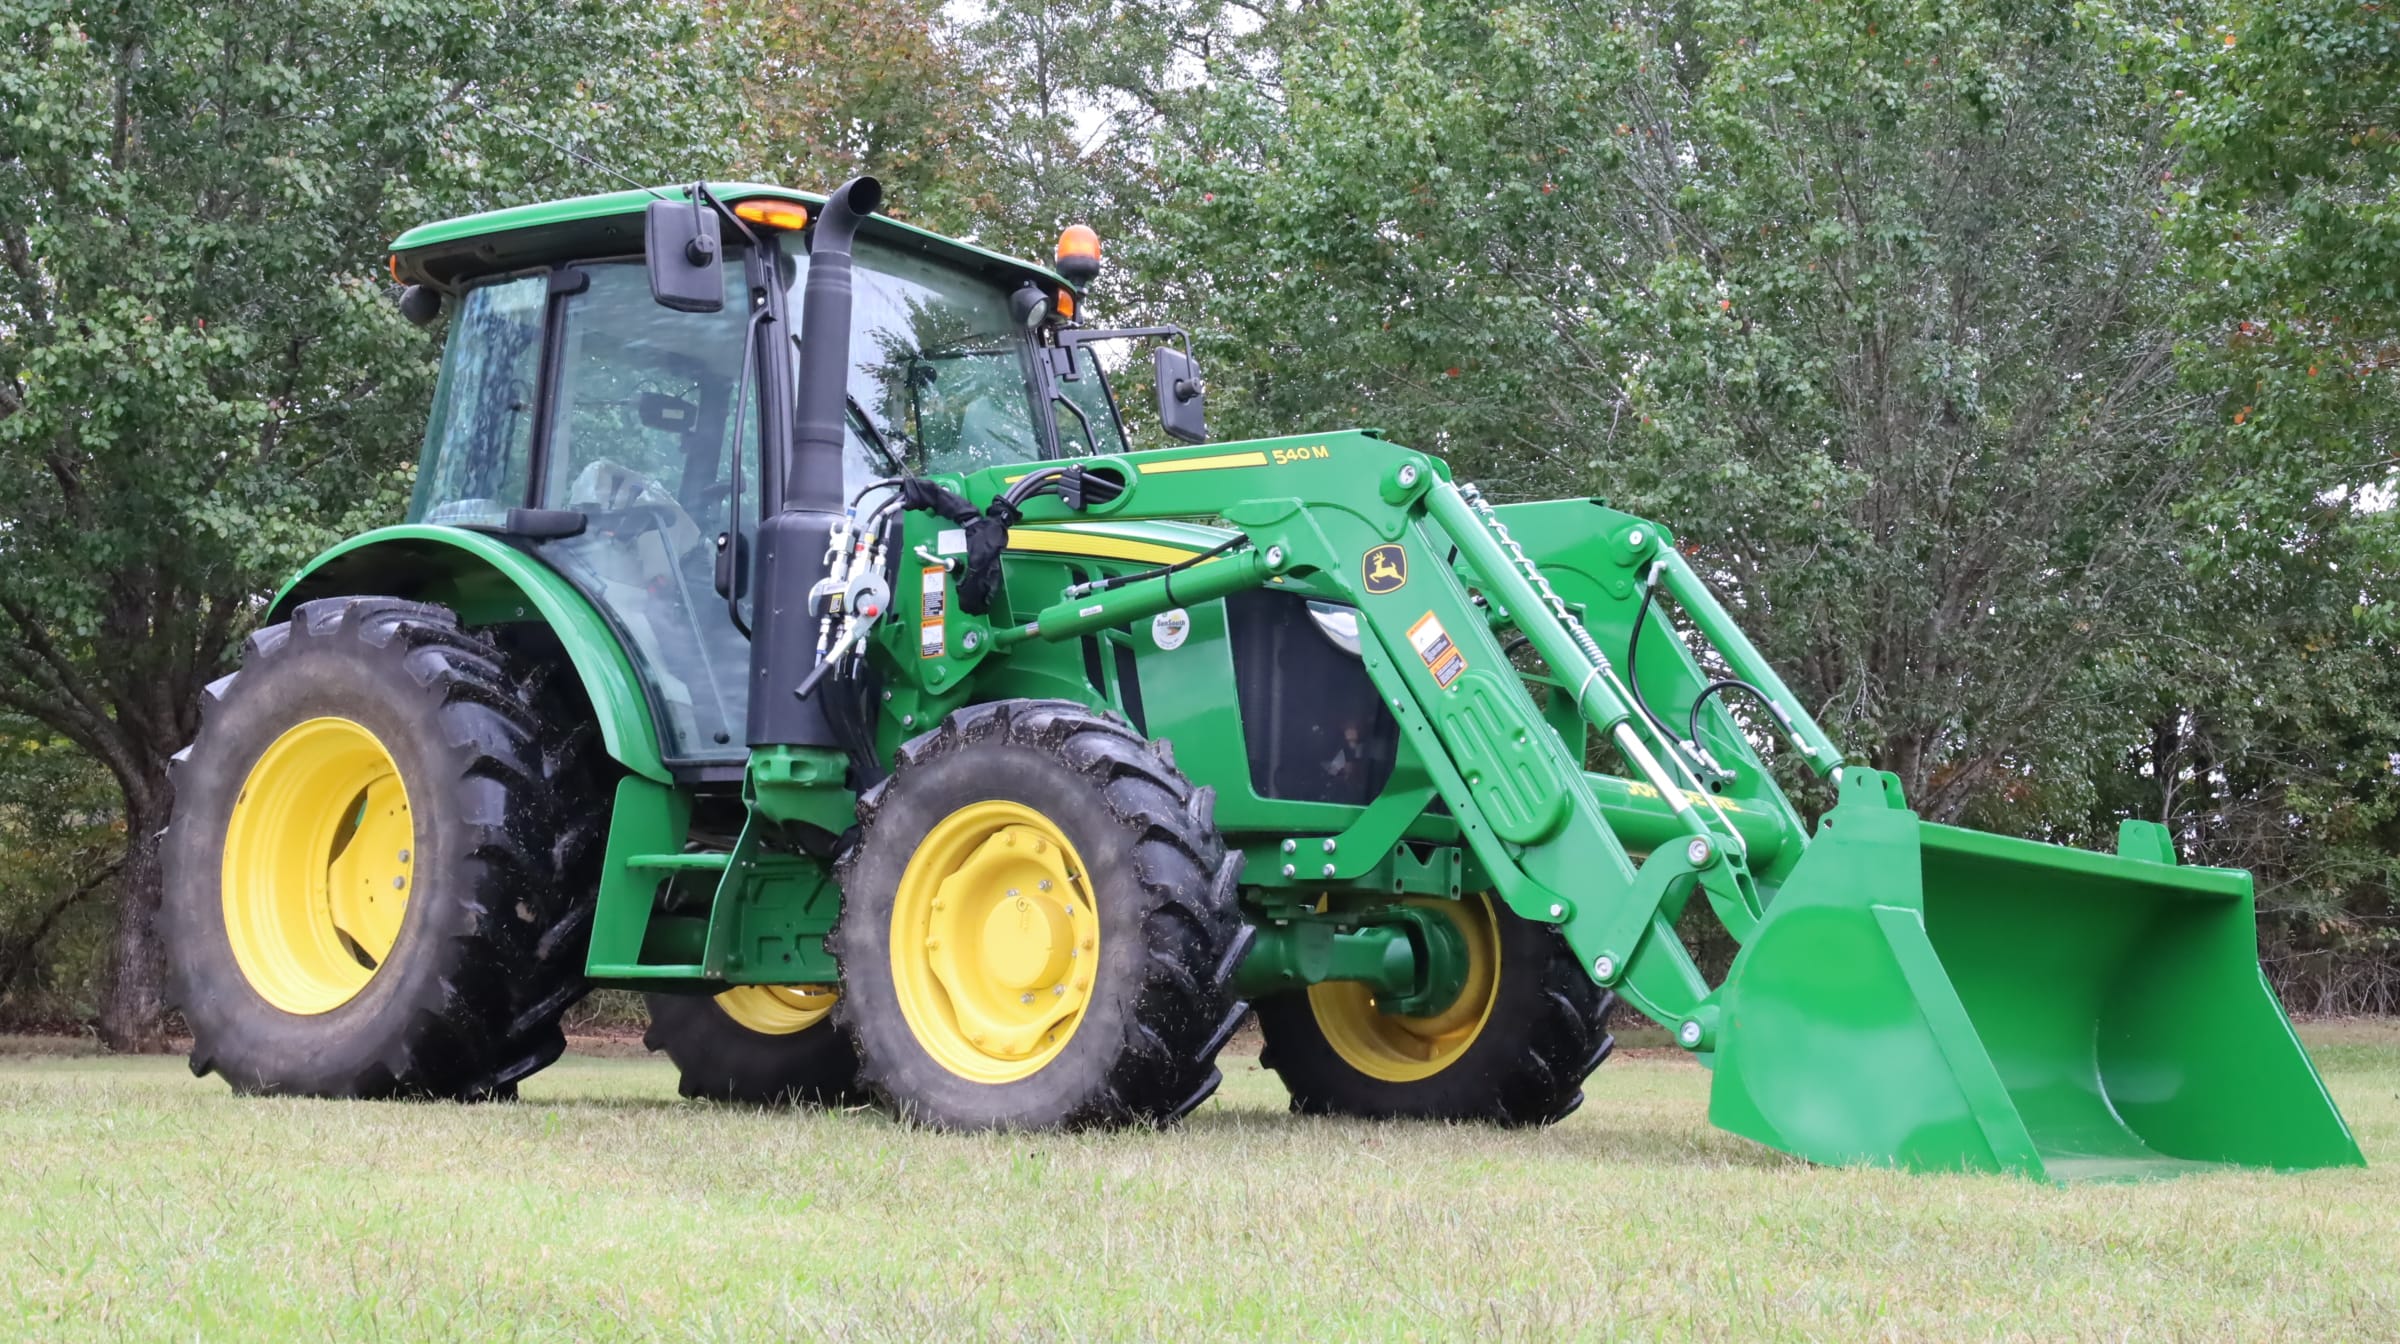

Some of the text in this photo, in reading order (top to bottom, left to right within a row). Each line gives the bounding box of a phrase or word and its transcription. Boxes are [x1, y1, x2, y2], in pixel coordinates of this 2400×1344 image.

[1271, 444, 1329, 465] 540 M
[1627, 781, 1743, 812] JOH DERE
